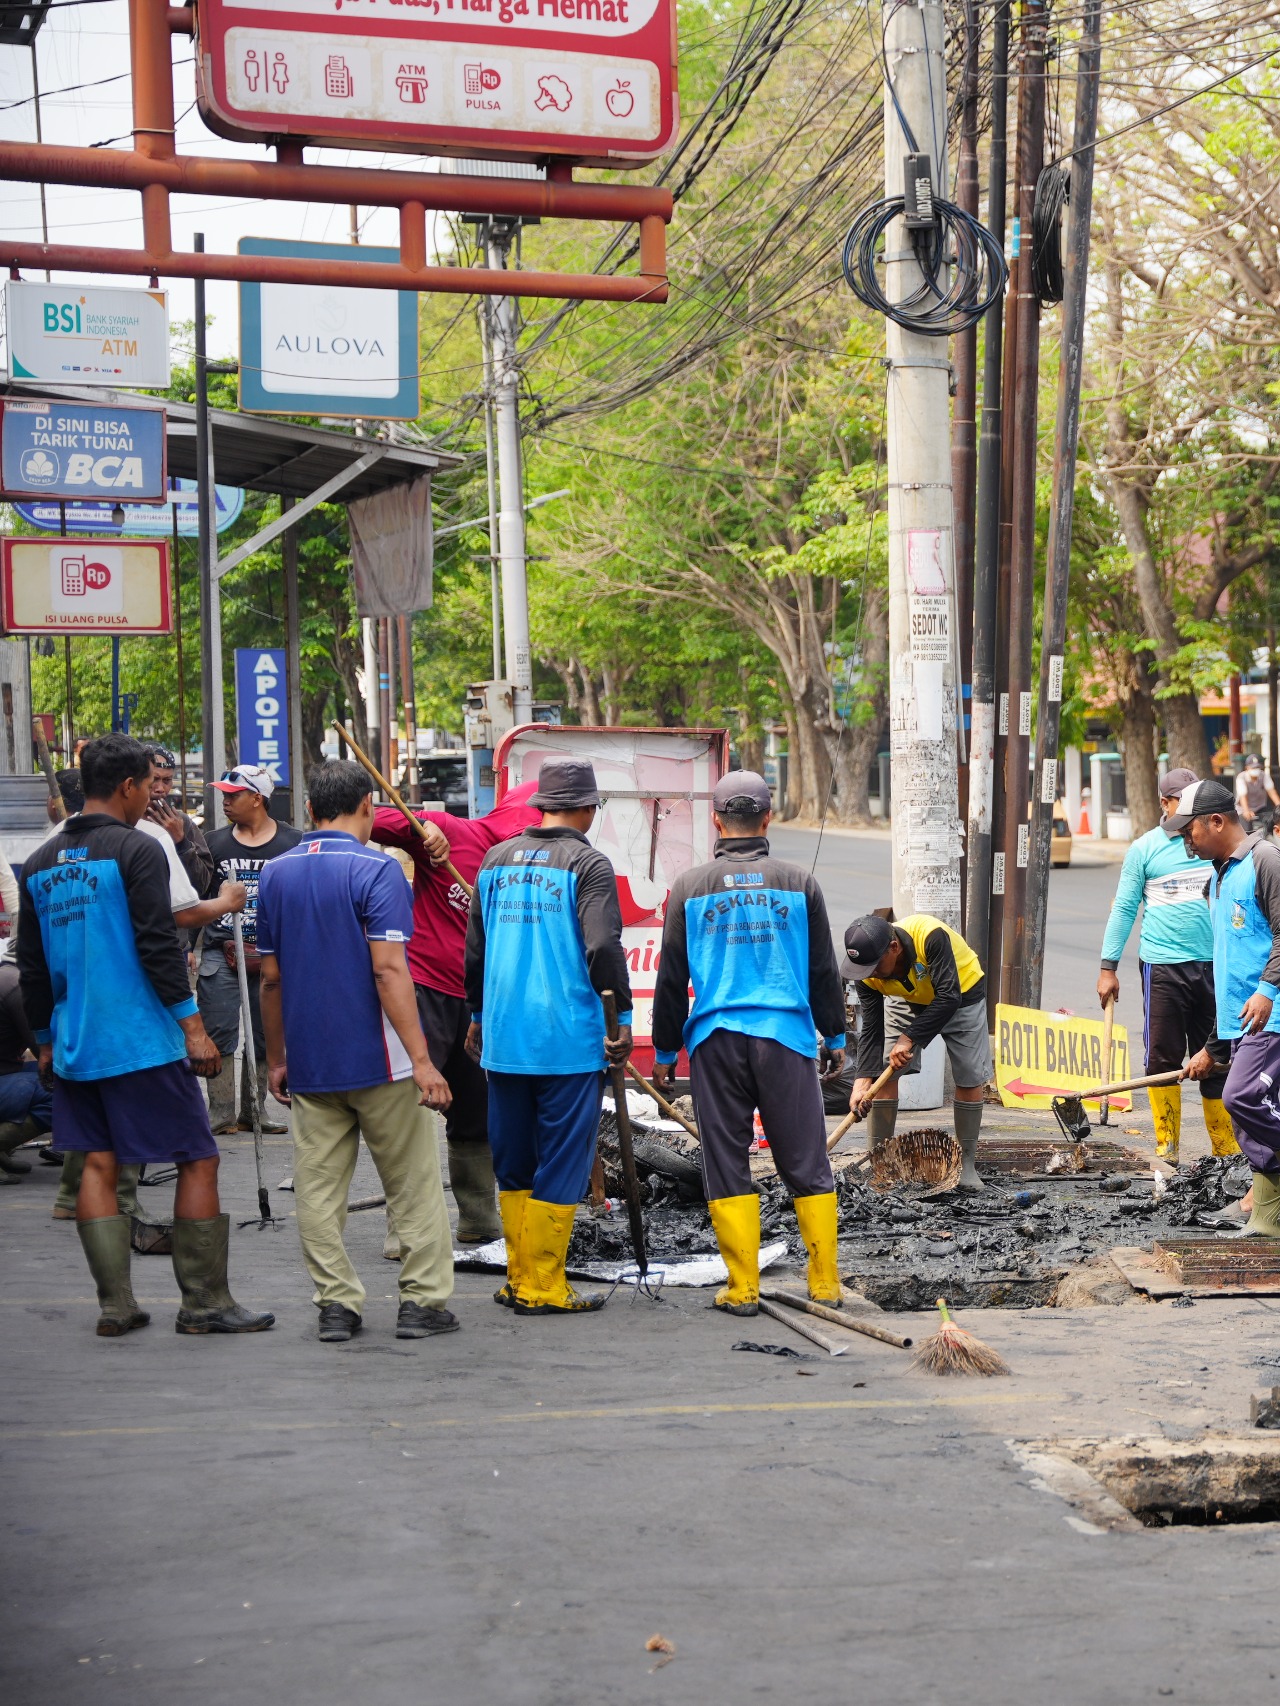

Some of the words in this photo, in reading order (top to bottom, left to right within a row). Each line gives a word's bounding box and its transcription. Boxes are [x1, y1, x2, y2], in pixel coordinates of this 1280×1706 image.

[537, 0, 629, 23] Hemat
[398, 64, 426, 76] ATM
[482, 73, 498, 87] Rp
[466, 99, 501, 111] PULSA
[44, 303, 81, 333] BSI
[86, 314, 107, 324] BANK
[108, 316, 140, 326] SYARIAH
[86, 325, 128, 336] INDONESIA
[101, 339, 138, 356] ATM
[275, 334, 384, 357] AULOVA
[35, 416, 52, 431] DI
[57, 418, 89, 433] SINI
[94, 421, 130, 435] BISA
[31, 432, 78, 448] TARIK
[82, 435, 133, 451] TUNAI
[64, 453, 143, 488] BCA
[86, 568, 106, 584] Rp
[45, 614, 57, 623] ISI
[60, 615, 94, 624] ULANG
[97, 615, 128, 624] PULSA
[912, 613, 937, 636] SEDOT
[939, 613, 948, 636] WC
[253, 654, 283, 781] APOTEK
[536, 850, 550, 860] SDA
[41, 867, 98, 894] EKARYA
[495, 872, 564, 902] EKARYA
[734, 873, 746, 884] PU
[747, 872, 764, 883] SDA
[543, 903, 562, 913] SOLO
[703, 893, 790, 923] PEKARYA
[1000, 1019, 1040, 1071] ROTI
[1045, 1027, 1102, 1080] BAKAR
